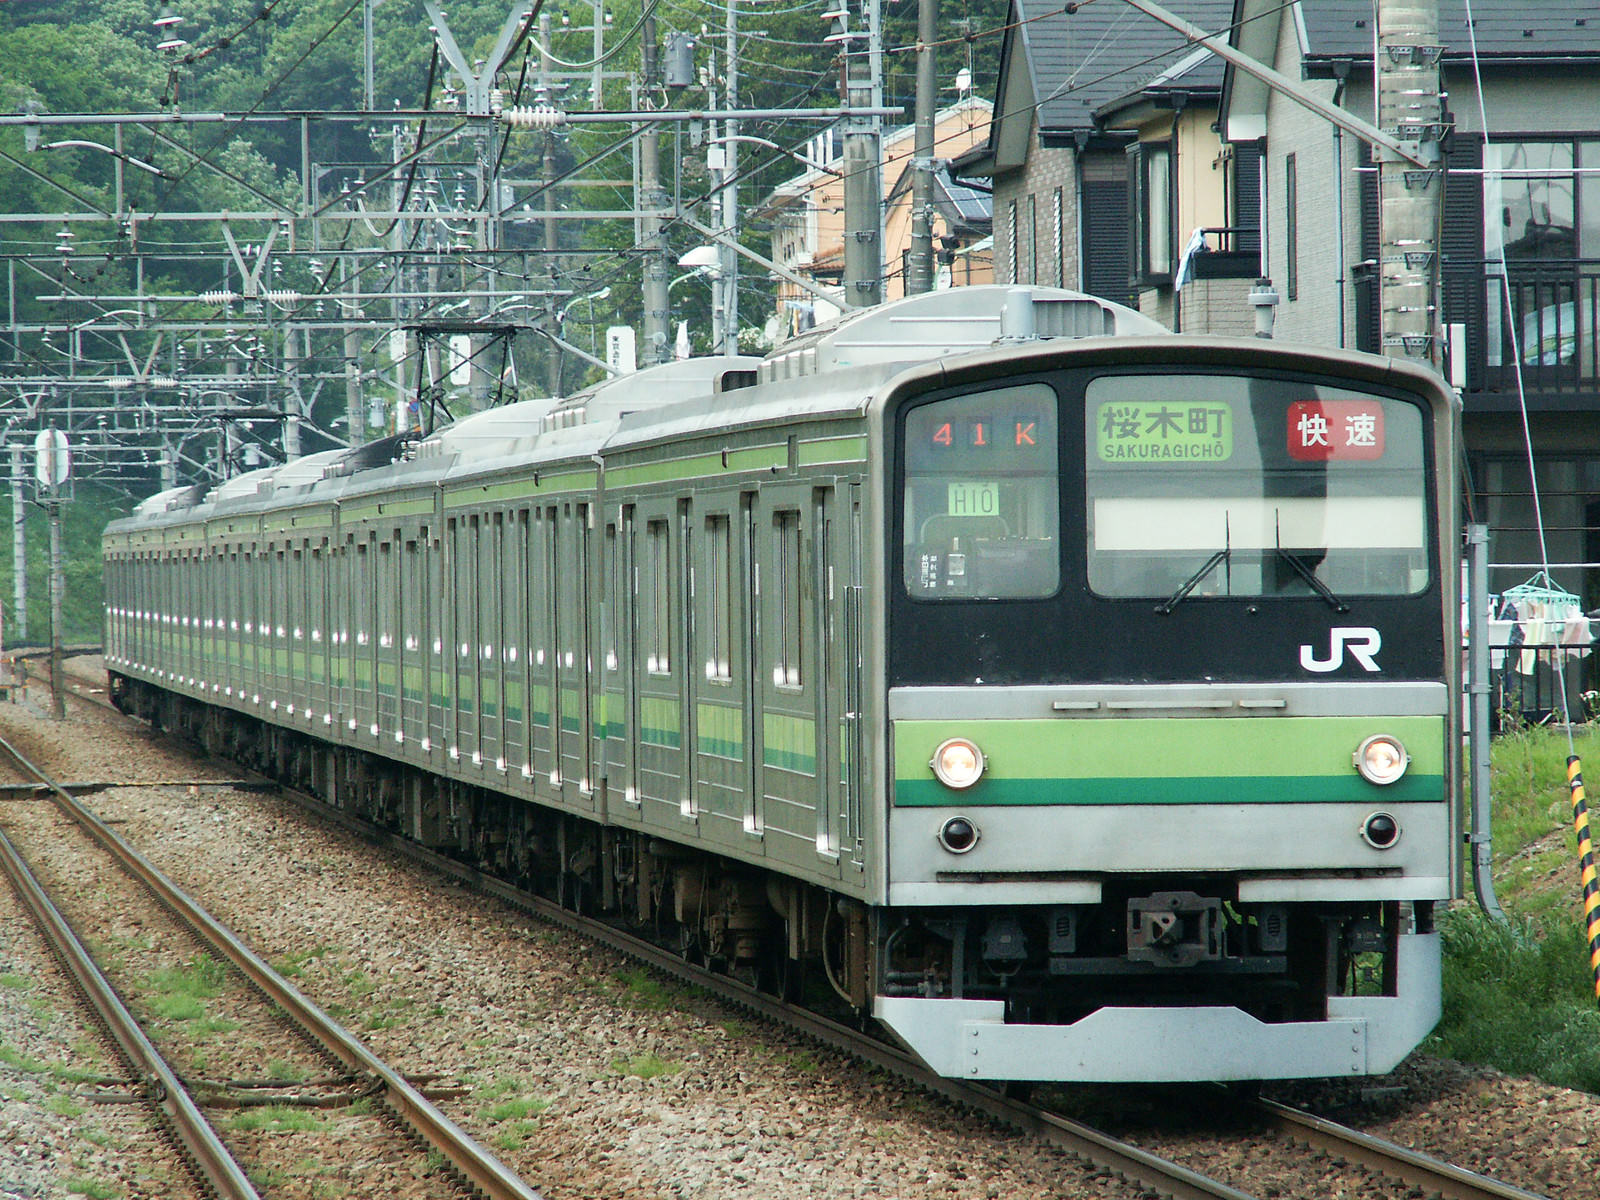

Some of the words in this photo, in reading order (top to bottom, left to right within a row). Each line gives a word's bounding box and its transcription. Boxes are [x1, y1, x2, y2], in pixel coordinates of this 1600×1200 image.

[1103, 406, 1226, 439] 桜木町
[1297, 413, 1376, 447] 快速
[1104, 440, 1224, 458] SAKURAGICHŌ
[1300, 627, 1382, 672] JR
